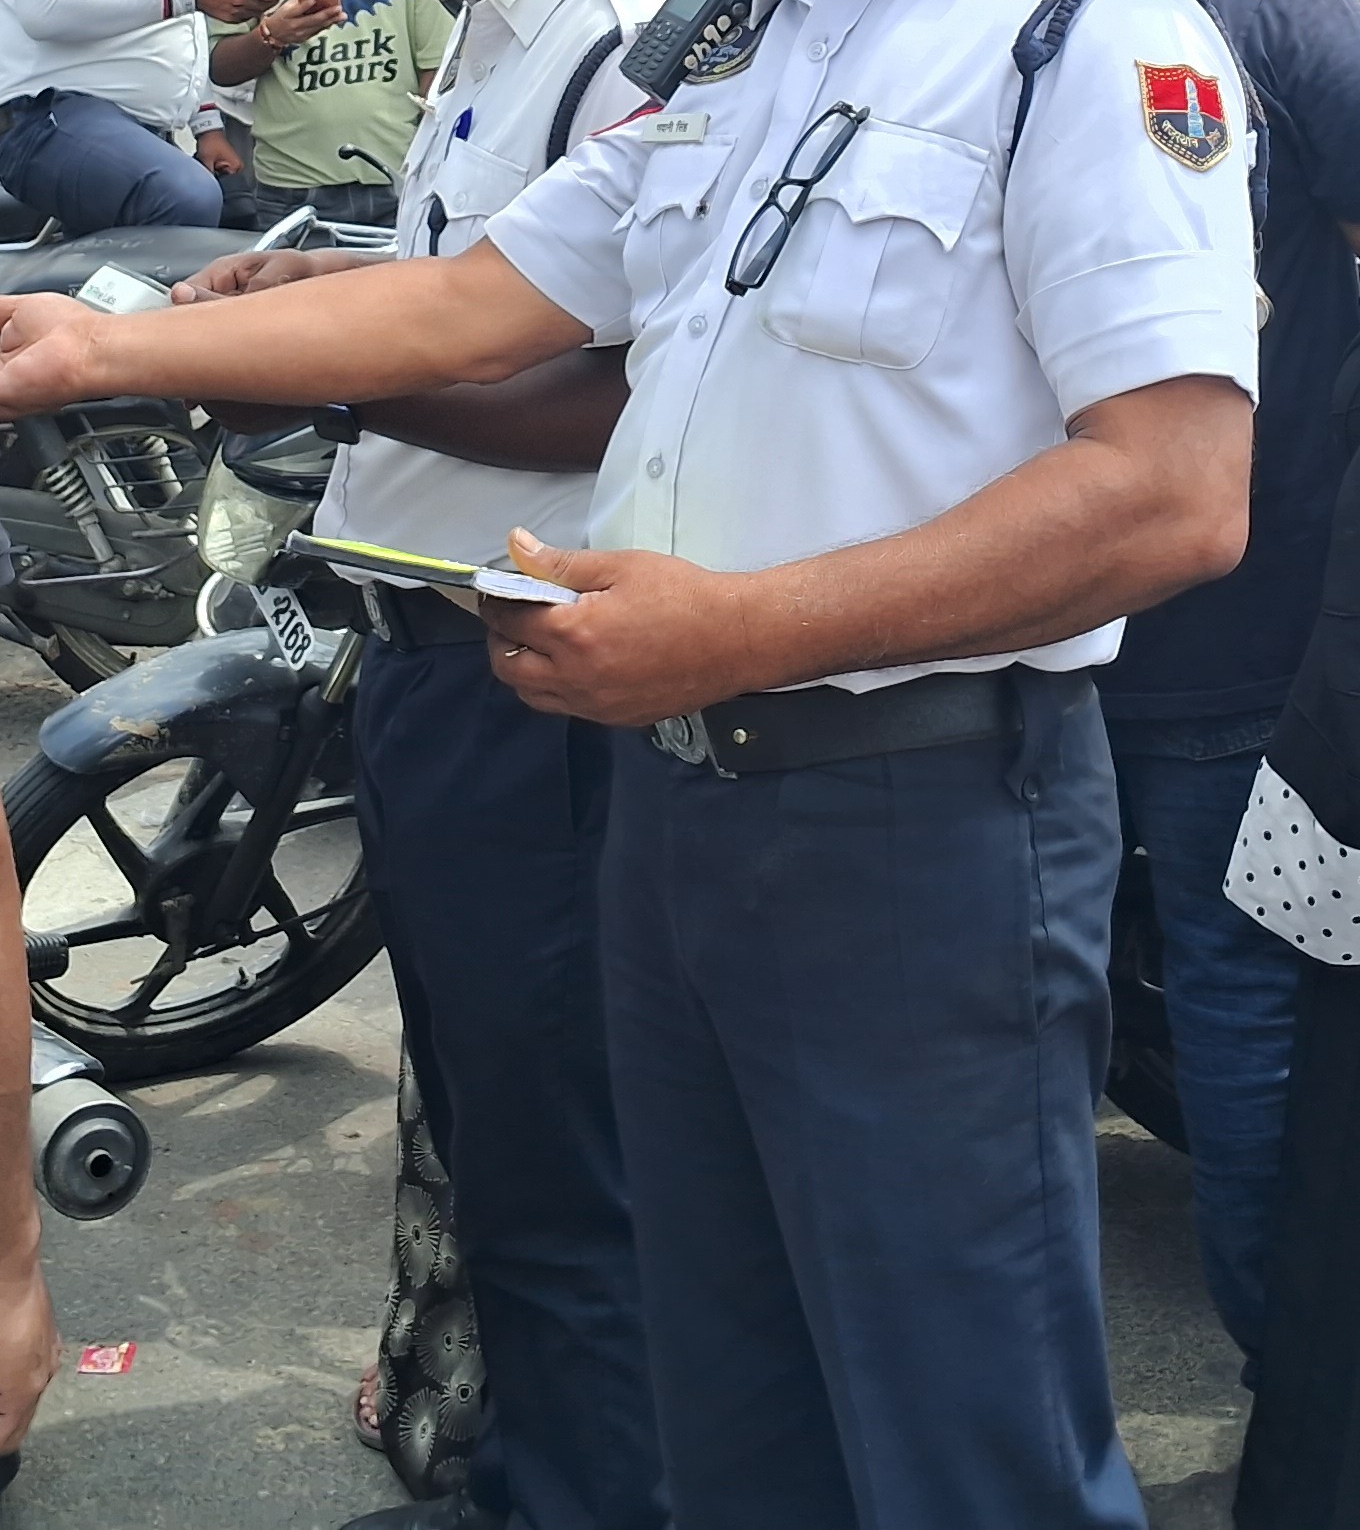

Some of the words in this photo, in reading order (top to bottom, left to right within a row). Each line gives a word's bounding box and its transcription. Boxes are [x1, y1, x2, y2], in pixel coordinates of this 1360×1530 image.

[306, 28, 396, 66] dark
[294, 58, 398, 92] hours
[271, 595, 312, 664] 2168
